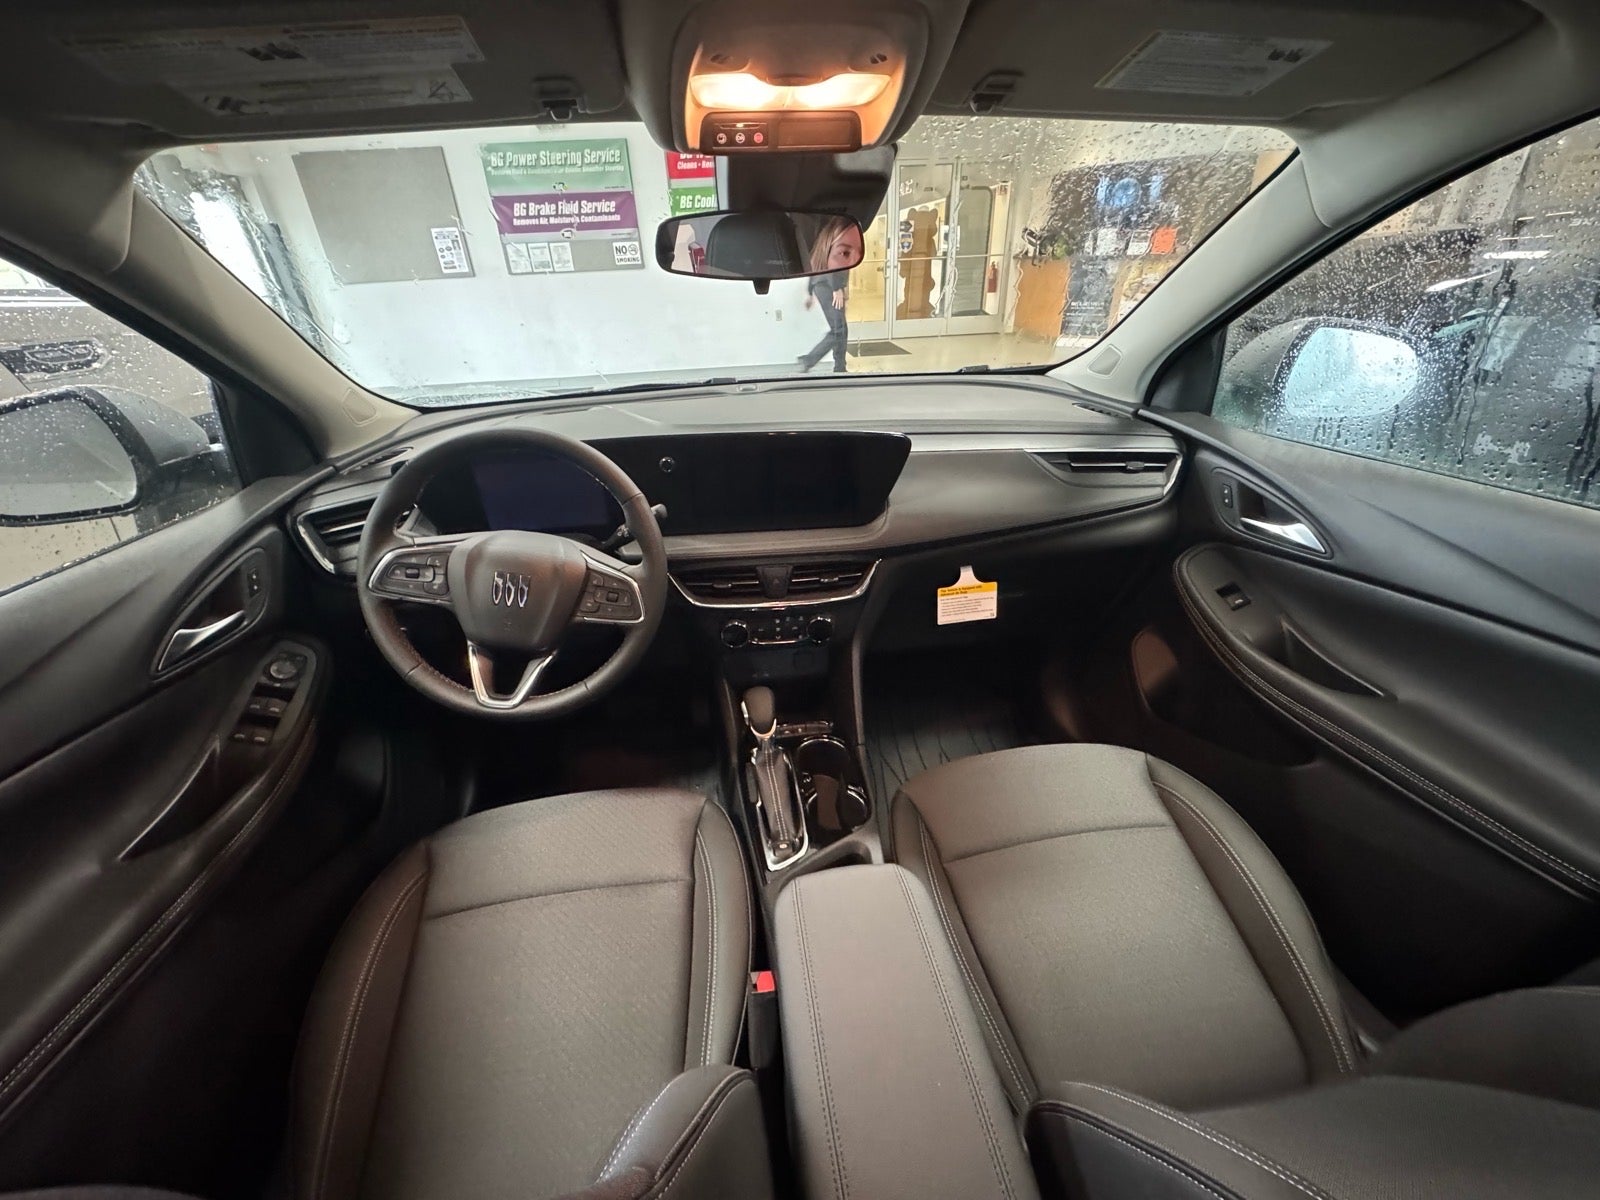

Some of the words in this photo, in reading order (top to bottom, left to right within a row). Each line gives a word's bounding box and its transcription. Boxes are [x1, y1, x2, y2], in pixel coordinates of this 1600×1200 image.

[491, 151, 504, 167] BG
[506, 151, 538, 167] Power
[540, 149, 581, 167] Steering
[584, 147, 620, 164] Service
[677, 161, 698, 170] Cleans
[513, 202, 527, 217] BG
[529, 200, 557, 216] Brake
[558, 199, 579, 215] Fluid
[581, 199, 616, 214] Service
[680, 195, 693, 209] BG
[513, 217, 539, 226] Removes
[549, 216, 574, 225] Moisture
[581, 214, 621, 223] Contaminants
[615, 245, 628, 255] NO
